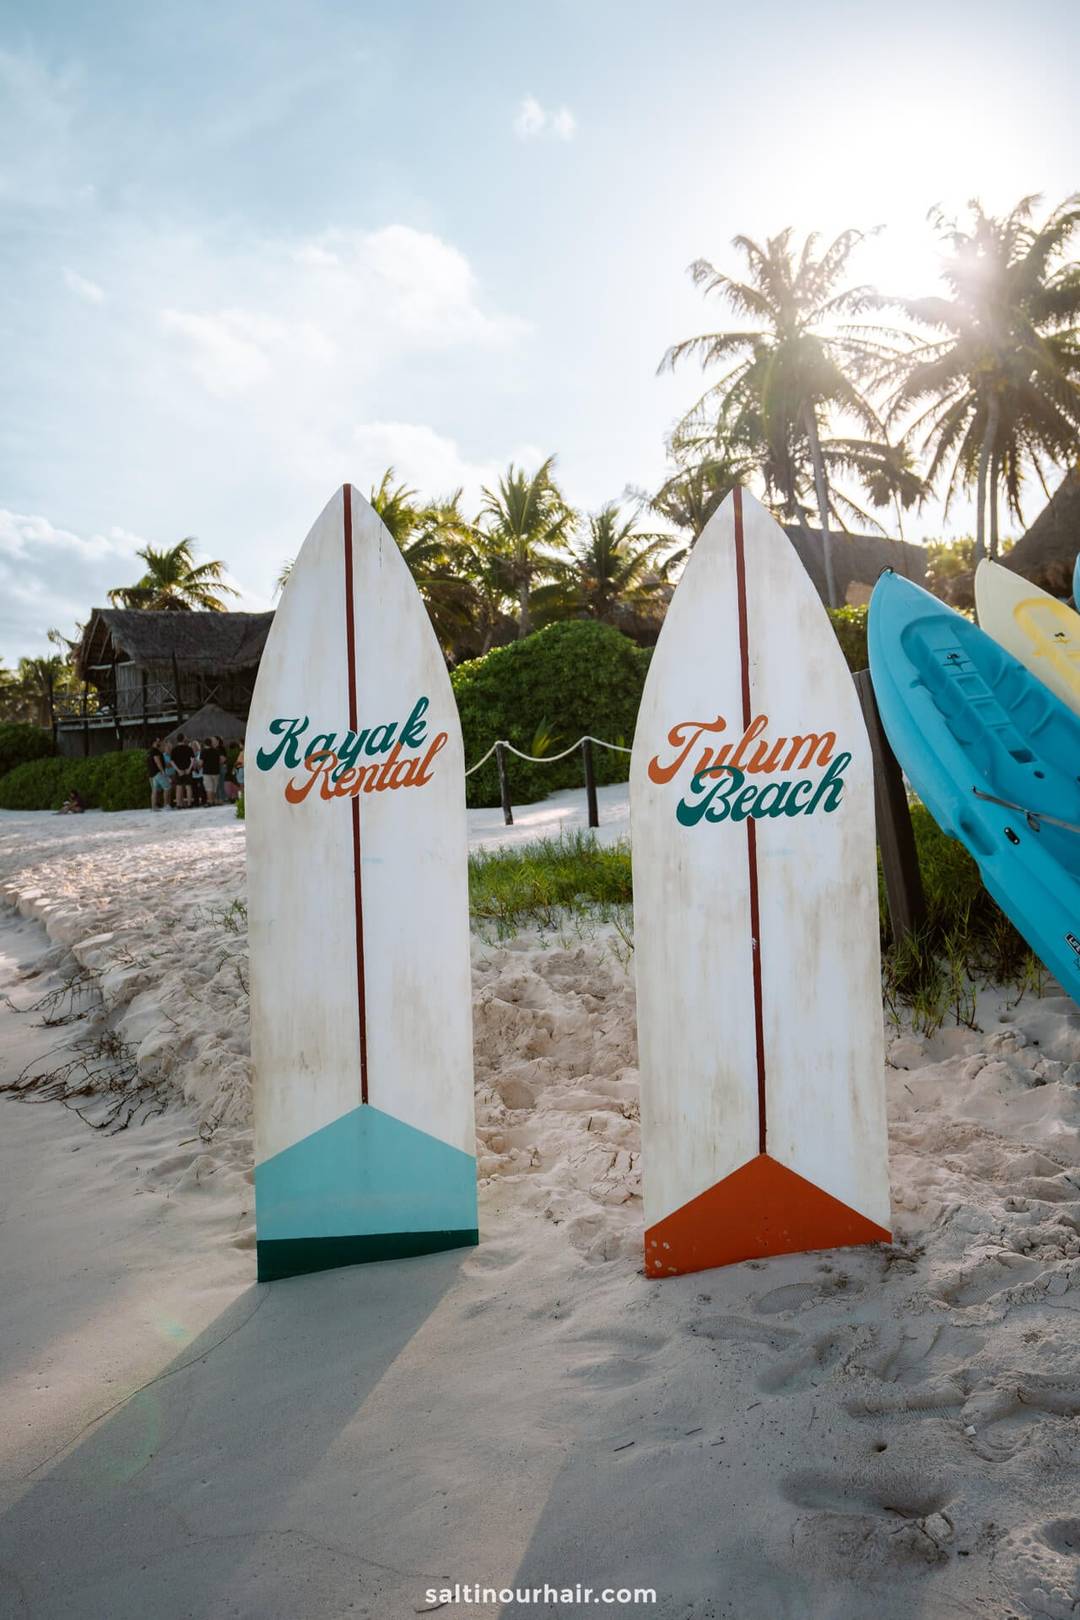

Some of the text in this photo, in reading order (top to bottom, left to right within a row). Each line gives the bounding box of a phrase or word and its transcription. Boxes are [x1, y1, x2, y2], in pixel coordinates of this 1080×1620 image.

[256, 696, 429, 783] Kayak
[285, 732, 448, 804] Rental
[648, 714, 837, 784] Tulum
[676, 752, 852, 826] Beach
